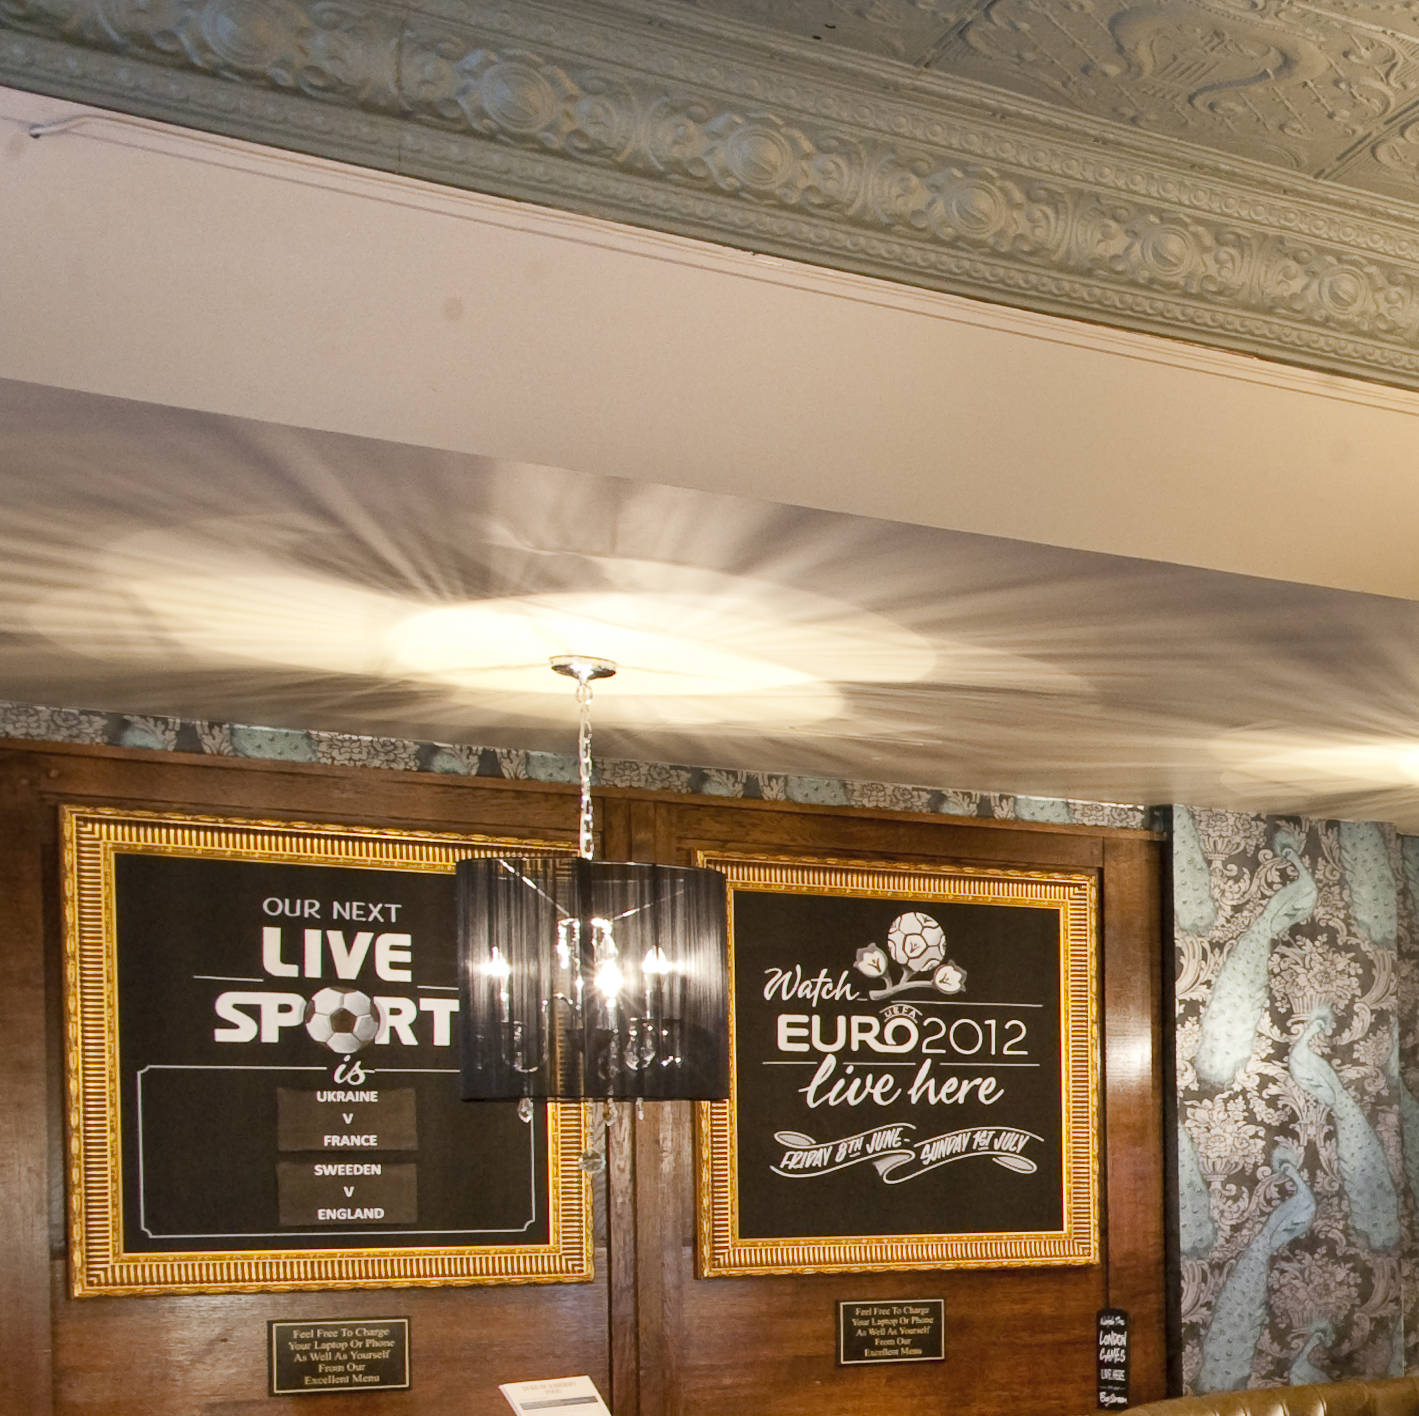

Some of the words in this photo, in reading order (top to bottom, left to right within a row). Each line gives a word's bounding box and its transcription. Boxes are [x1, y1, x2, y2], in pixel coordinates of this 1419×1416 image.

[263, 897, 321, 919] OUR
[333, 901, 402, 922] NEXT
[262, 926, 412, 983] LIVE
[763, 964, 861, 1007] Watch
[333, 1054, 375, 1086] is
[798, 1053, 902, 1109] live
[908, 1058, 1005, 1106] here
[316, 1091, 379, 1103] UKRAINE
[323, 1135, 378, 1147] FRANCE
[780, 1146, 833, 1170] FRIDAY
[834, 1137, 864, 1163] 8TH
[920, 1132, 971, 1166] SUNDAY
[994, 1132, 1030, 1153] JULY
[314, 1164, 382, 1176] SWEEDEN
[317, 1208, 385, 1221] ENGLAND
[293, 1329, 314, 1339] Feel
[317, 1329, 339, 1338] Free
[341, 1327, 354, 1337] To
[355, 1327, 390, 1338] Charge
[1099, 1330, 1128, 1347] LONDON
[288, 1341, 312, 1351] Your
[314, 1340, 348, 1351] Laptop
[350, 1339, 364, 1349] Or
[365, 1338, 396, 1348] Phone
[294, 1353, 308, 1363] As
[310, 1352, 332, 1362] Well
[334, 1351, 348, 1361] As
[350, 1349, 391, 1360] Yourself
[318, 1363, 345, 1373] From
[347, 1362, 367, 1372] Our
[304, 1375, 350, 1385] Excellent
[352, 1373, 381, 1383] Menu
